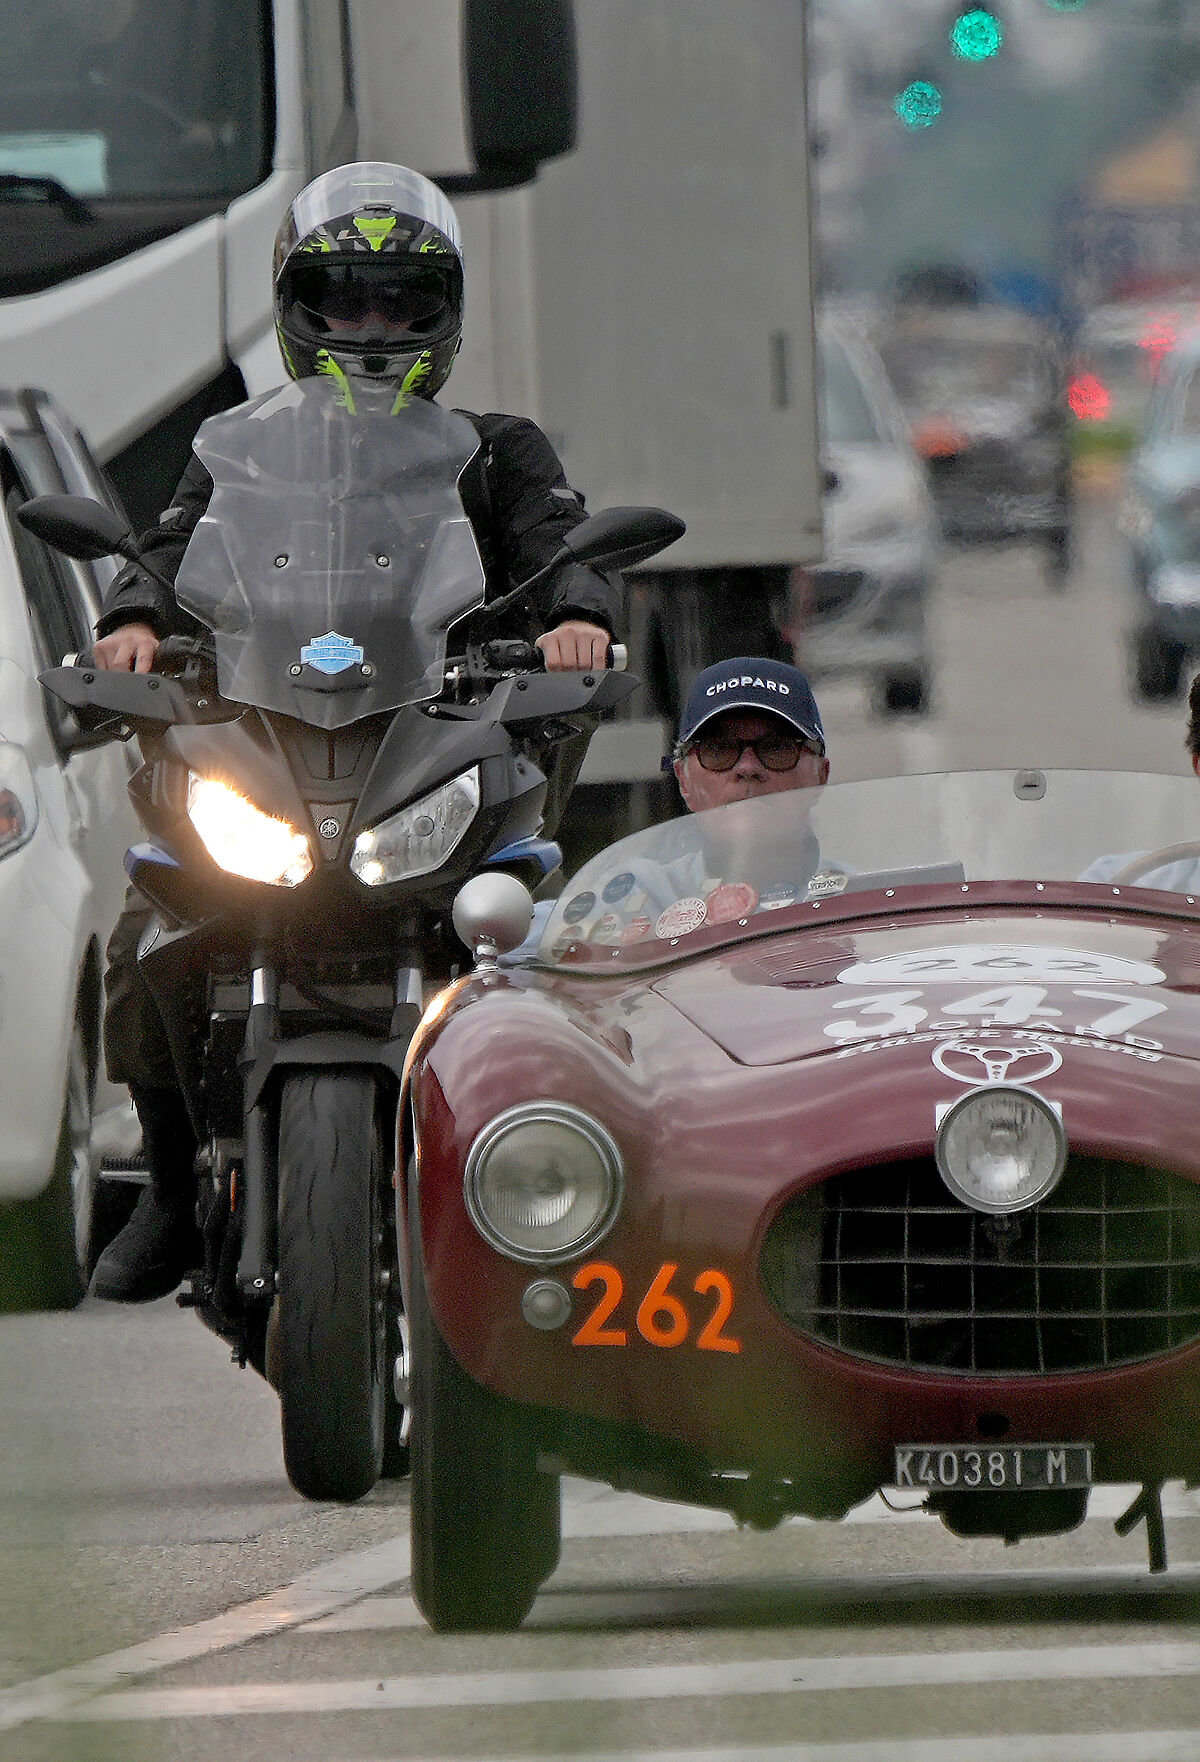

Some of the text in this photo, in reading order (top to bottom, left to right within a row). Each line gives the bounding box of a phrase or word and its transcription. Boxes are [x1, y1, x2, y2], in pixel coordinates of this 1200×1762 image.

[706, 675, 790, 697] CHOPARD
[901, 956, 1103, 974] 262
[823, 986, 1169, 1038] 347
[572, 1260, 742, 1354] 262
[895, 1450, 1022, 1487] K40381
